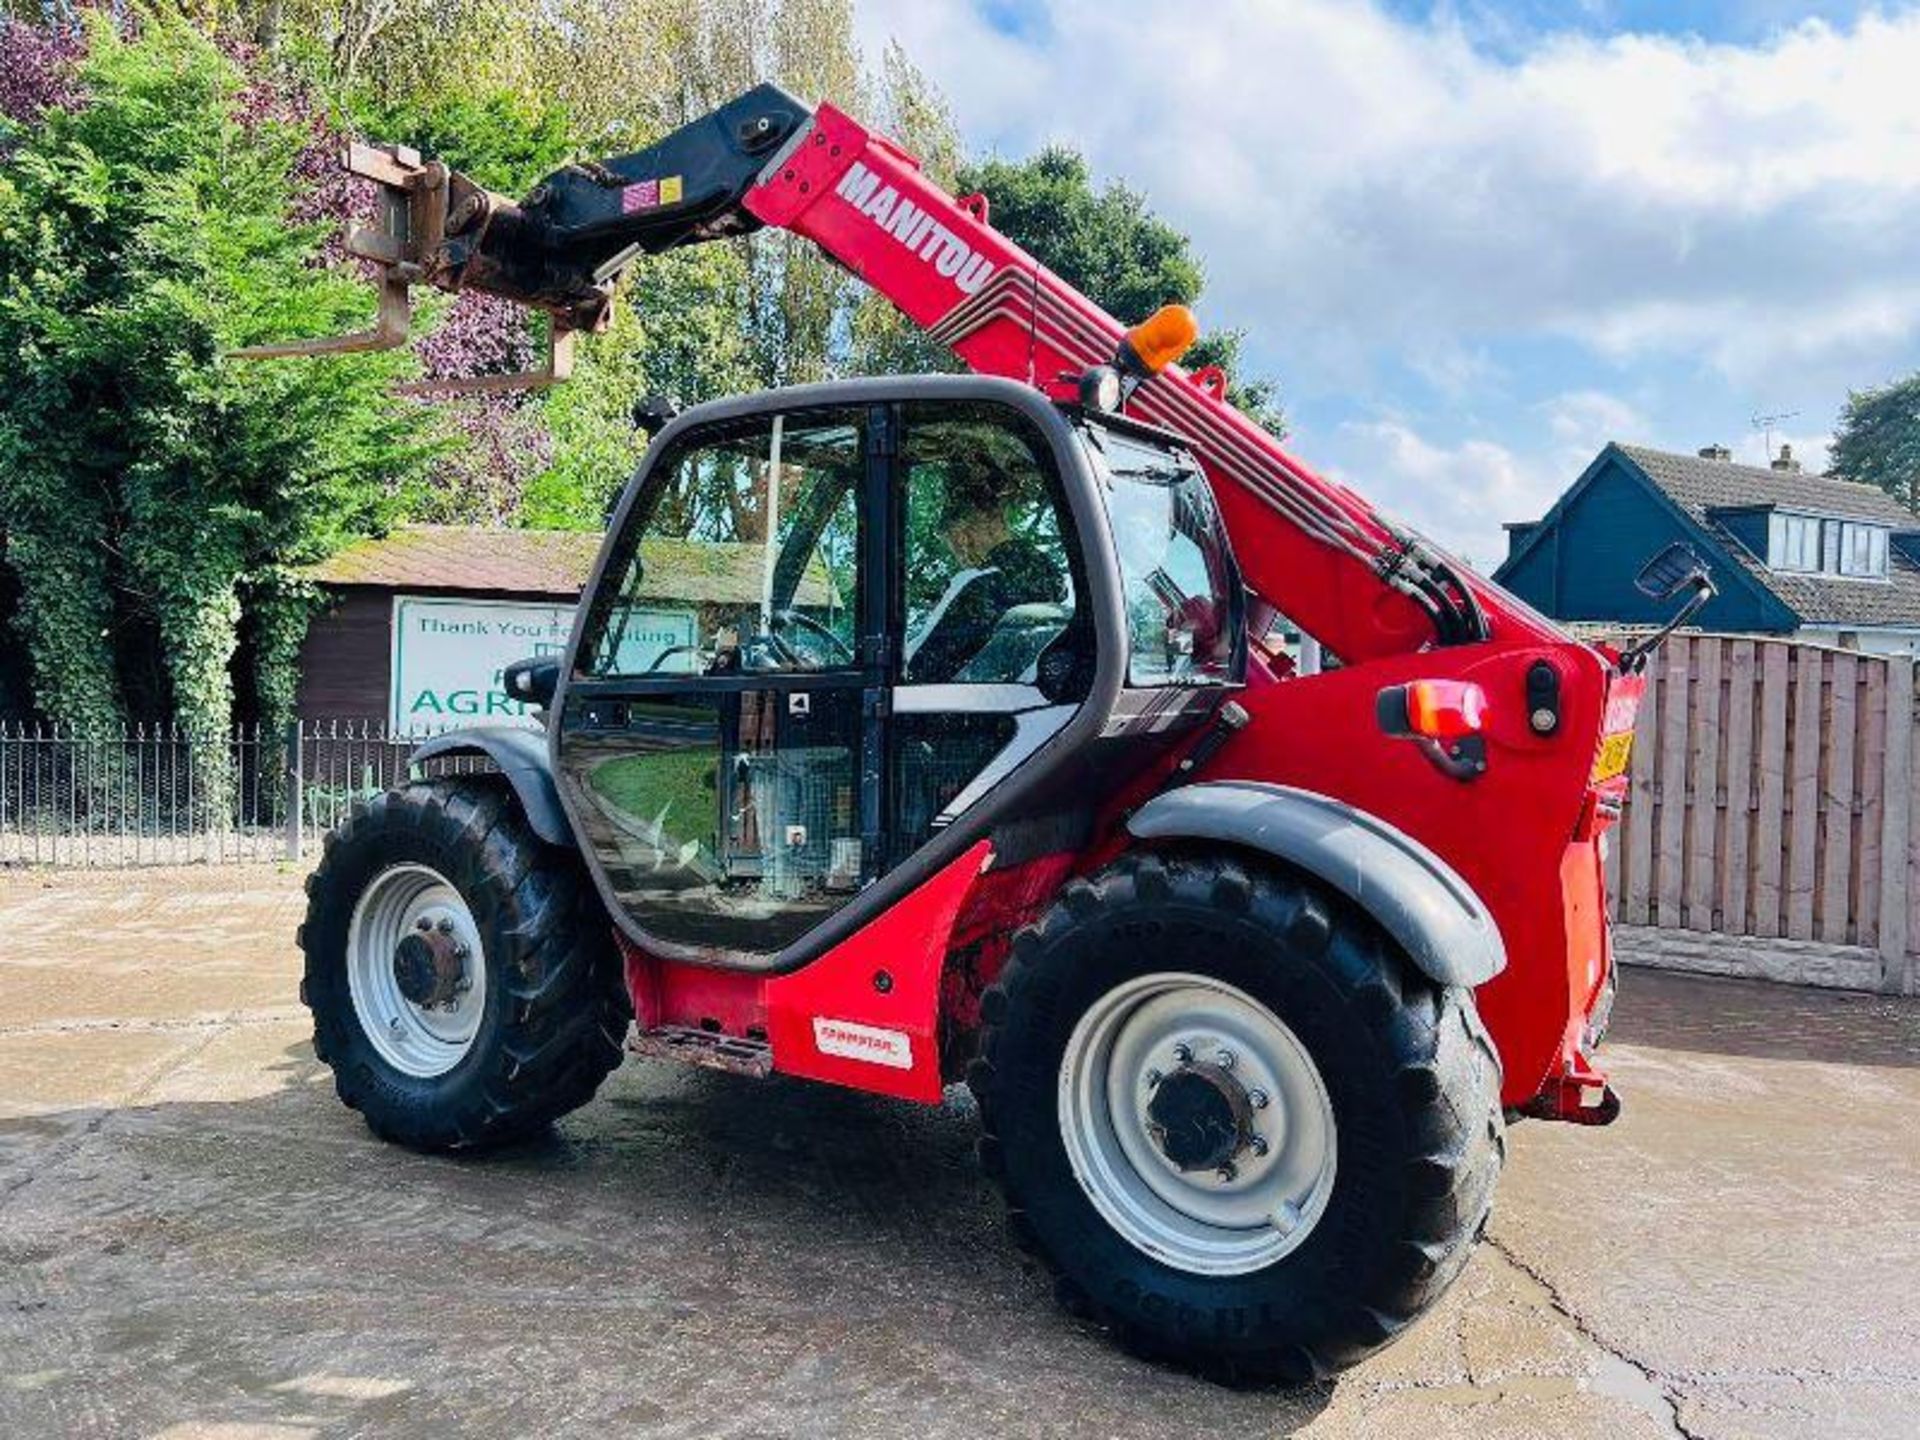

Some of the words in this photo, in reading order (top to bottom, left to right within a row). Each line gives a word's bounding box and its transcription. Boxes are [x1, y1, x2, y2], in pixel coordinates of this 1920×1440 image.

[835, 161, 995, 296] MANITOU
[421, 618, 488, 635] Thank
[499, 621, 542, 637] You
[549, 624, 573, 637] Fo
